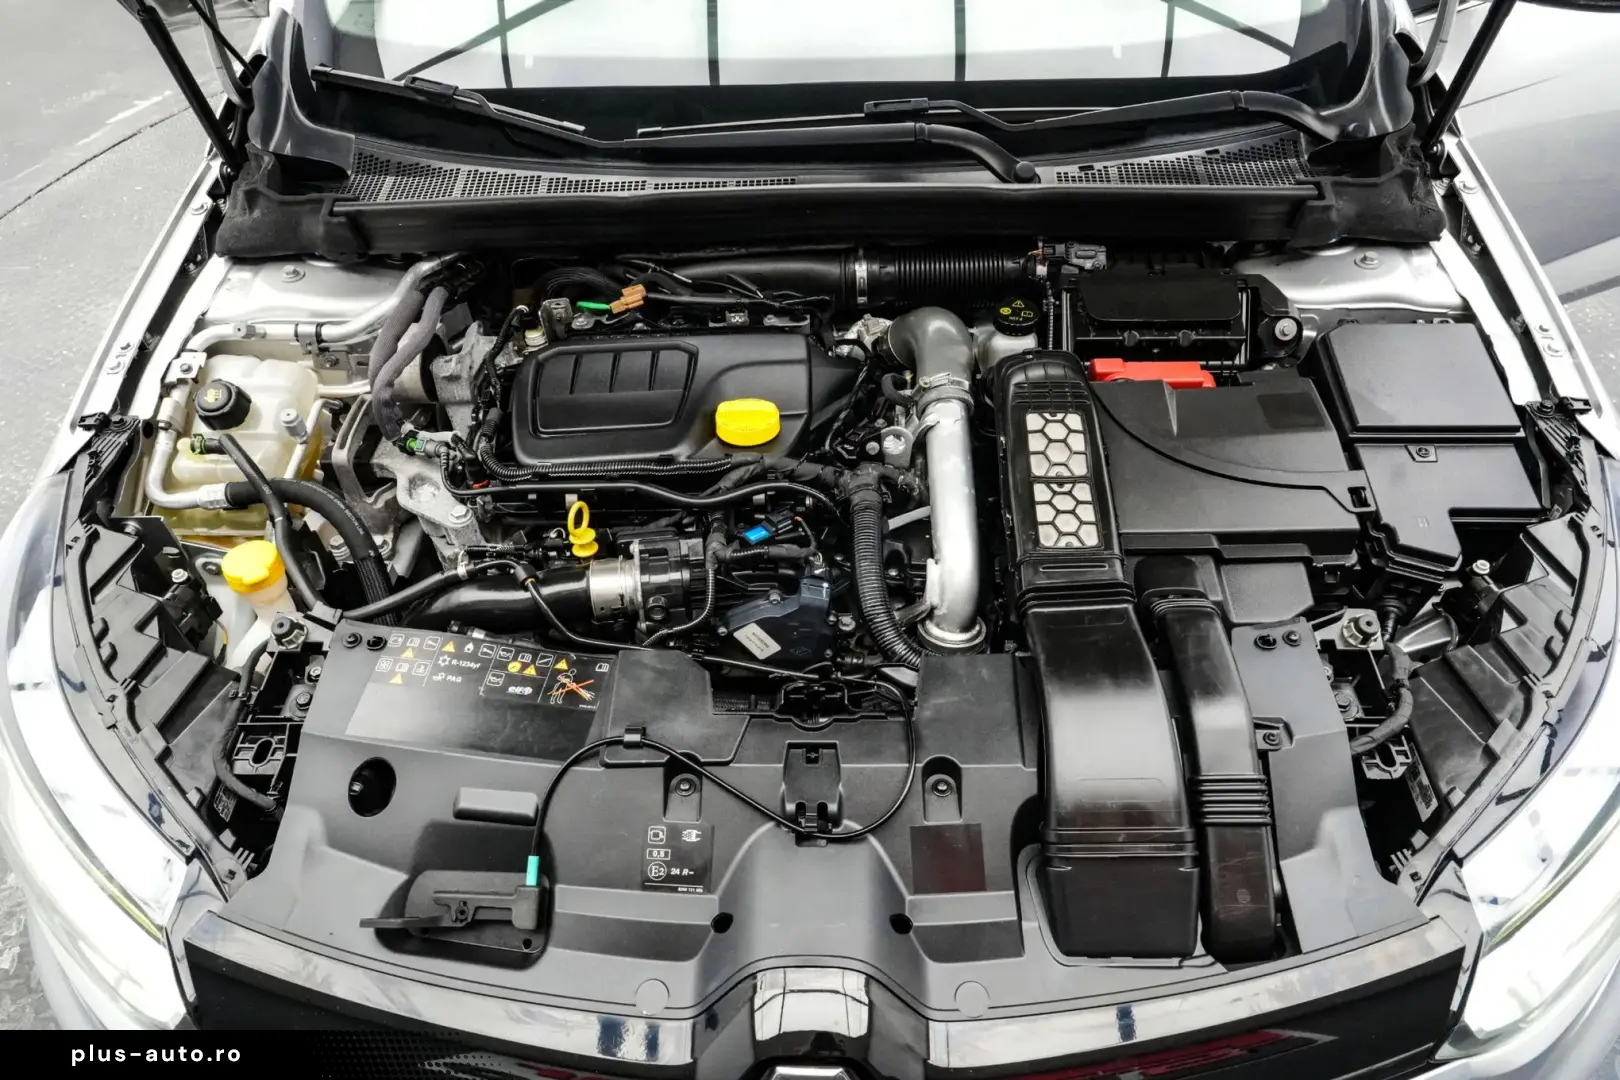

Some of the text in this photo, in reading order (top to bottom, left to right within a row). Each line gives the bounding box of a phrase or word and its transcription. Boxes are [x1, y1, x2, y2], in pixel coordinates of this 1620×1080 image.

[451, 660, 481, 669] R-1234yf
[446, 675, 462, 683] PAG
[651, 865, 665, 877] E2
